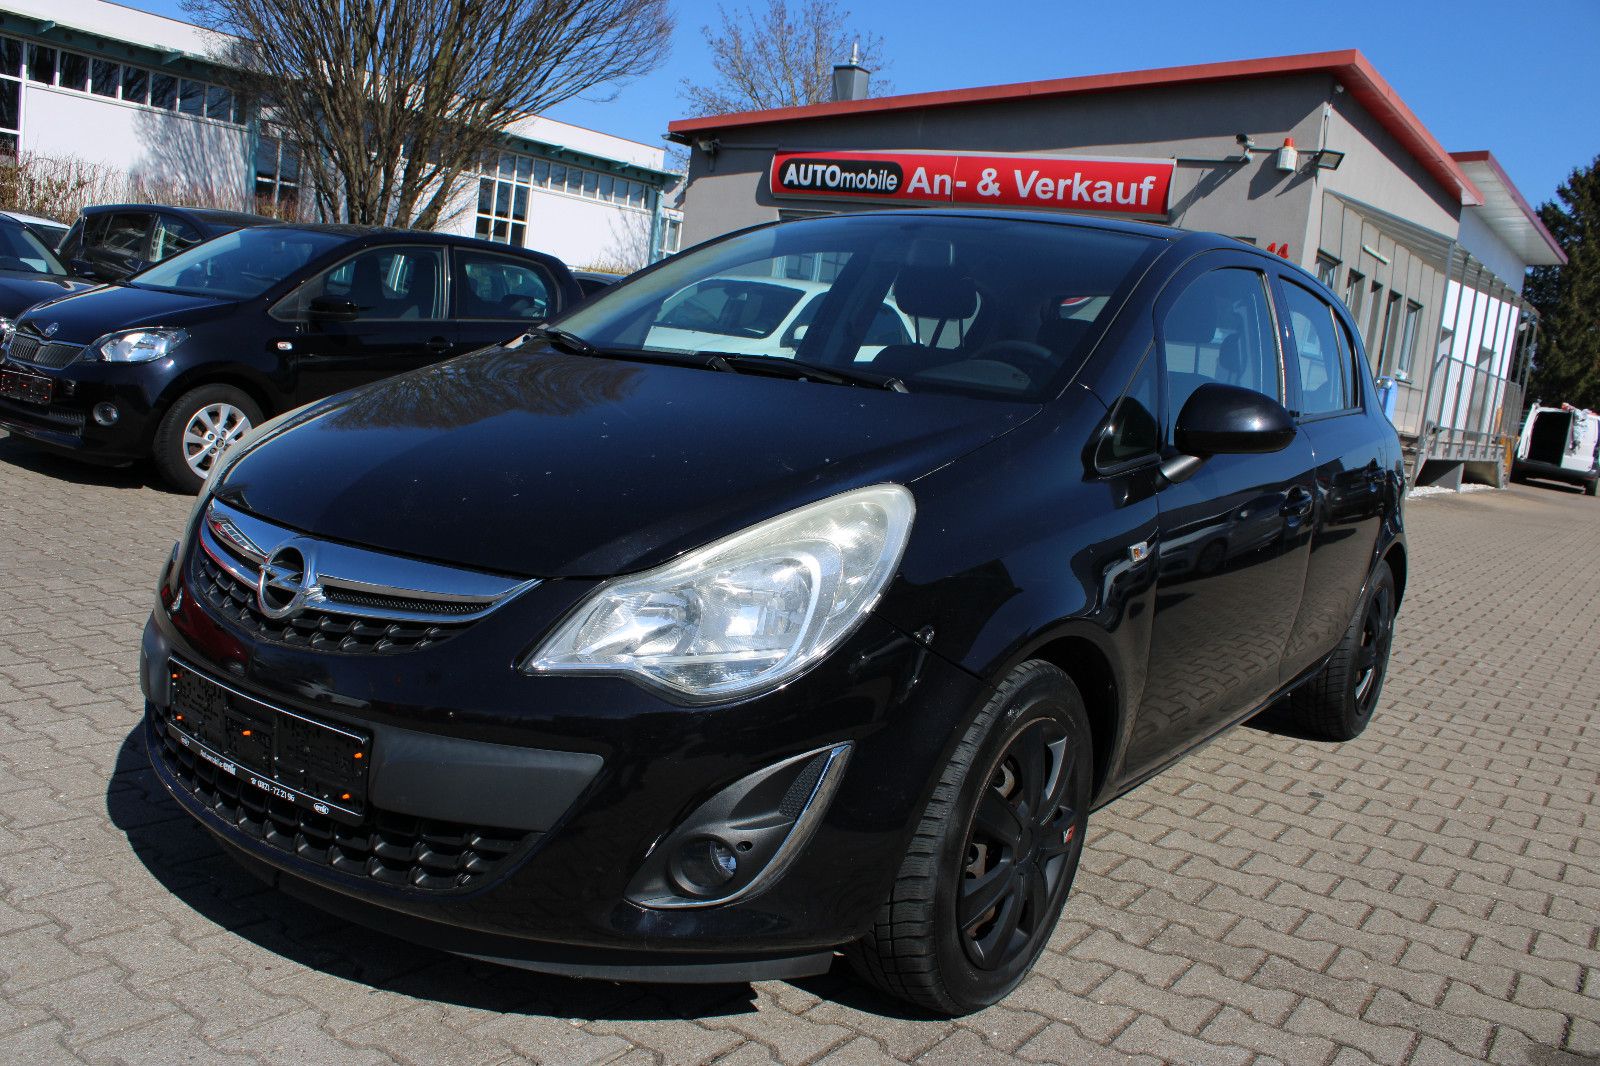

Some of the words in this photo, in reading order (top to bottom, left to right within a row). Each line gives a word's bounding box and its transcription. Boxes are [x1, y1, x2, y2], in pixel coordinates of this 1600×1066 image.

[783, 162, 898, 192] AUTOmobile
[906, 167, 967, 195] An-
[976, 168, 1001, 198] &
[1014, 169, 1157, 206] Verkauf
